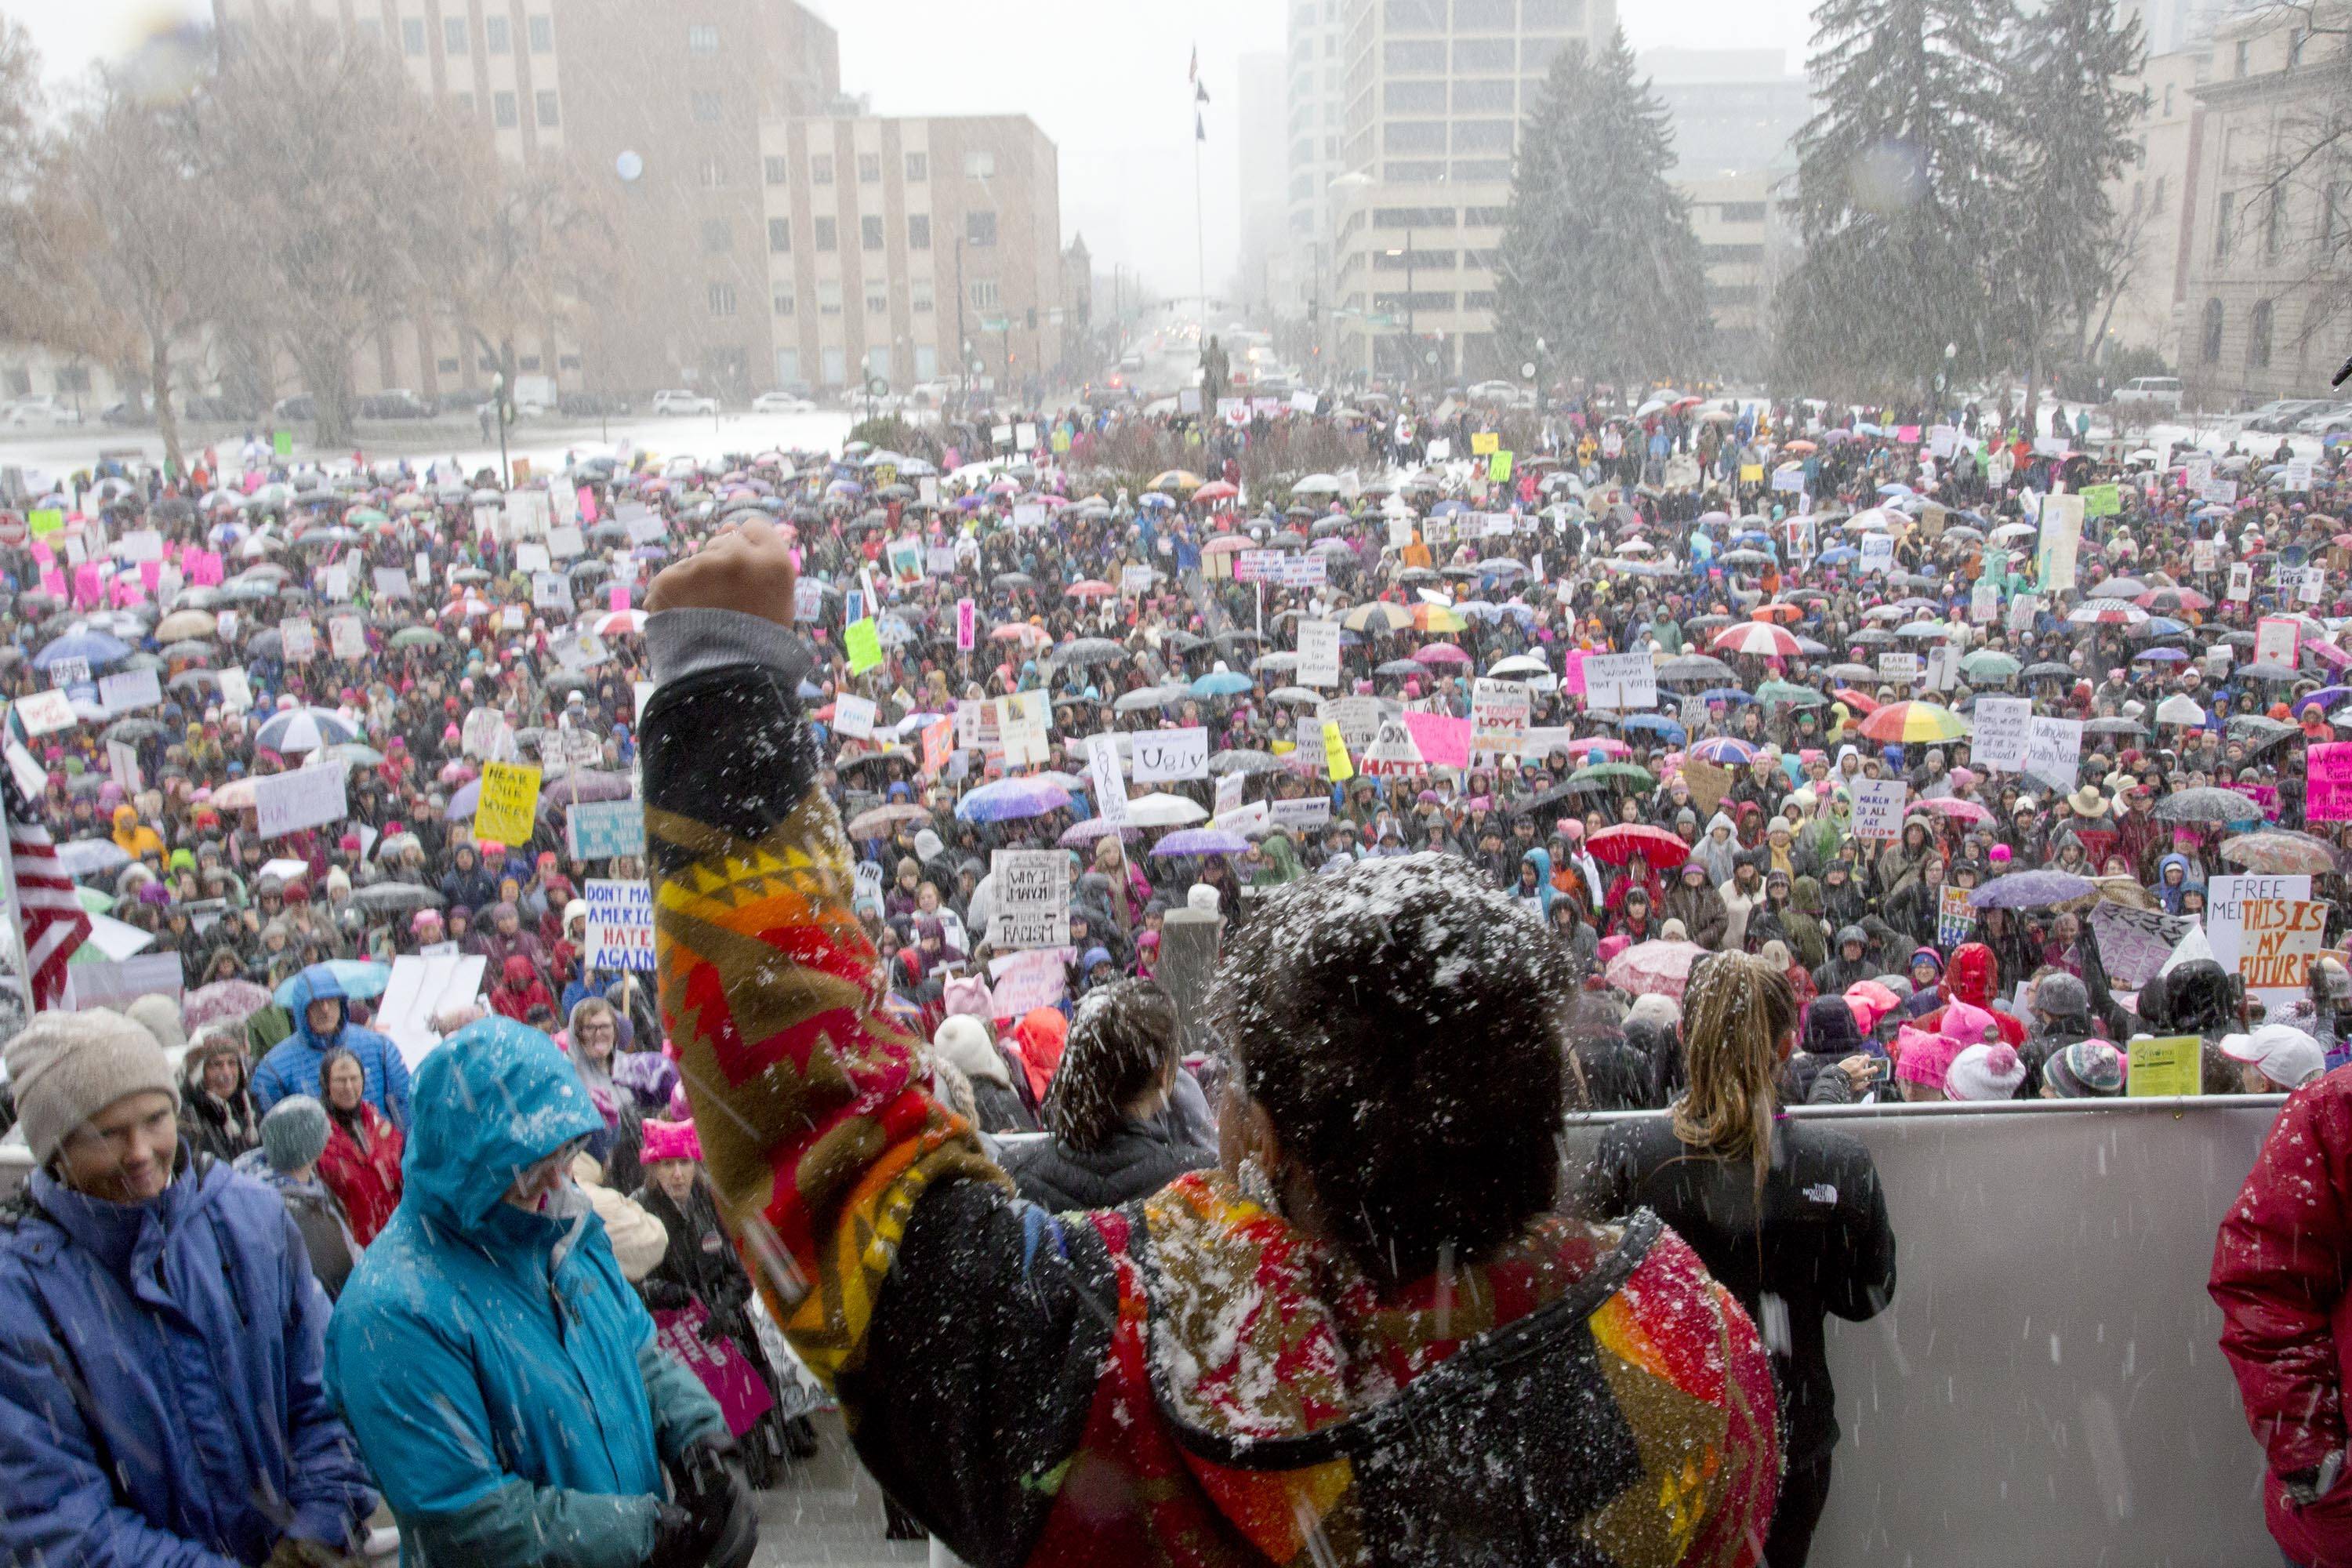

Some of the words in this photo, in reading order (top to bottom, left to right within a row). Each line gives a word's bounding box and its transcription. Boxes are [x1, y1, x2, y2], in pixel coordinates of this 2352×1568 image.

[1479, 716, 1526, 730] LOVE
[1142, 746, 1203, 778] Ugly
[1362, 758, 1425, 776] HATE
[488, 766, 528, 786] HEAR
[1873, 782, 1881, 791] I
[1860, 795, 1889, 804] MARCH
[1870, 807, 1887, 816] ALL
[1853, 826, 1885, 837] LOVED
[1011, 870, 1037, 884] WHY
[1040, 870, 1048, 884] I
[2232, 879, 2285, 899] FREE
[2242, 899, 2286, 931] THIS
[2286, 902, 2324, 931] IS
[604, 927, 652, 946] HATE
[1003, 924, 1054, 943] RACISM
[2257, 931, 2288, 955] MY
[596, 948, 655, 970] AGAIN
[2239, 953, 2315, 986] FUTURE
